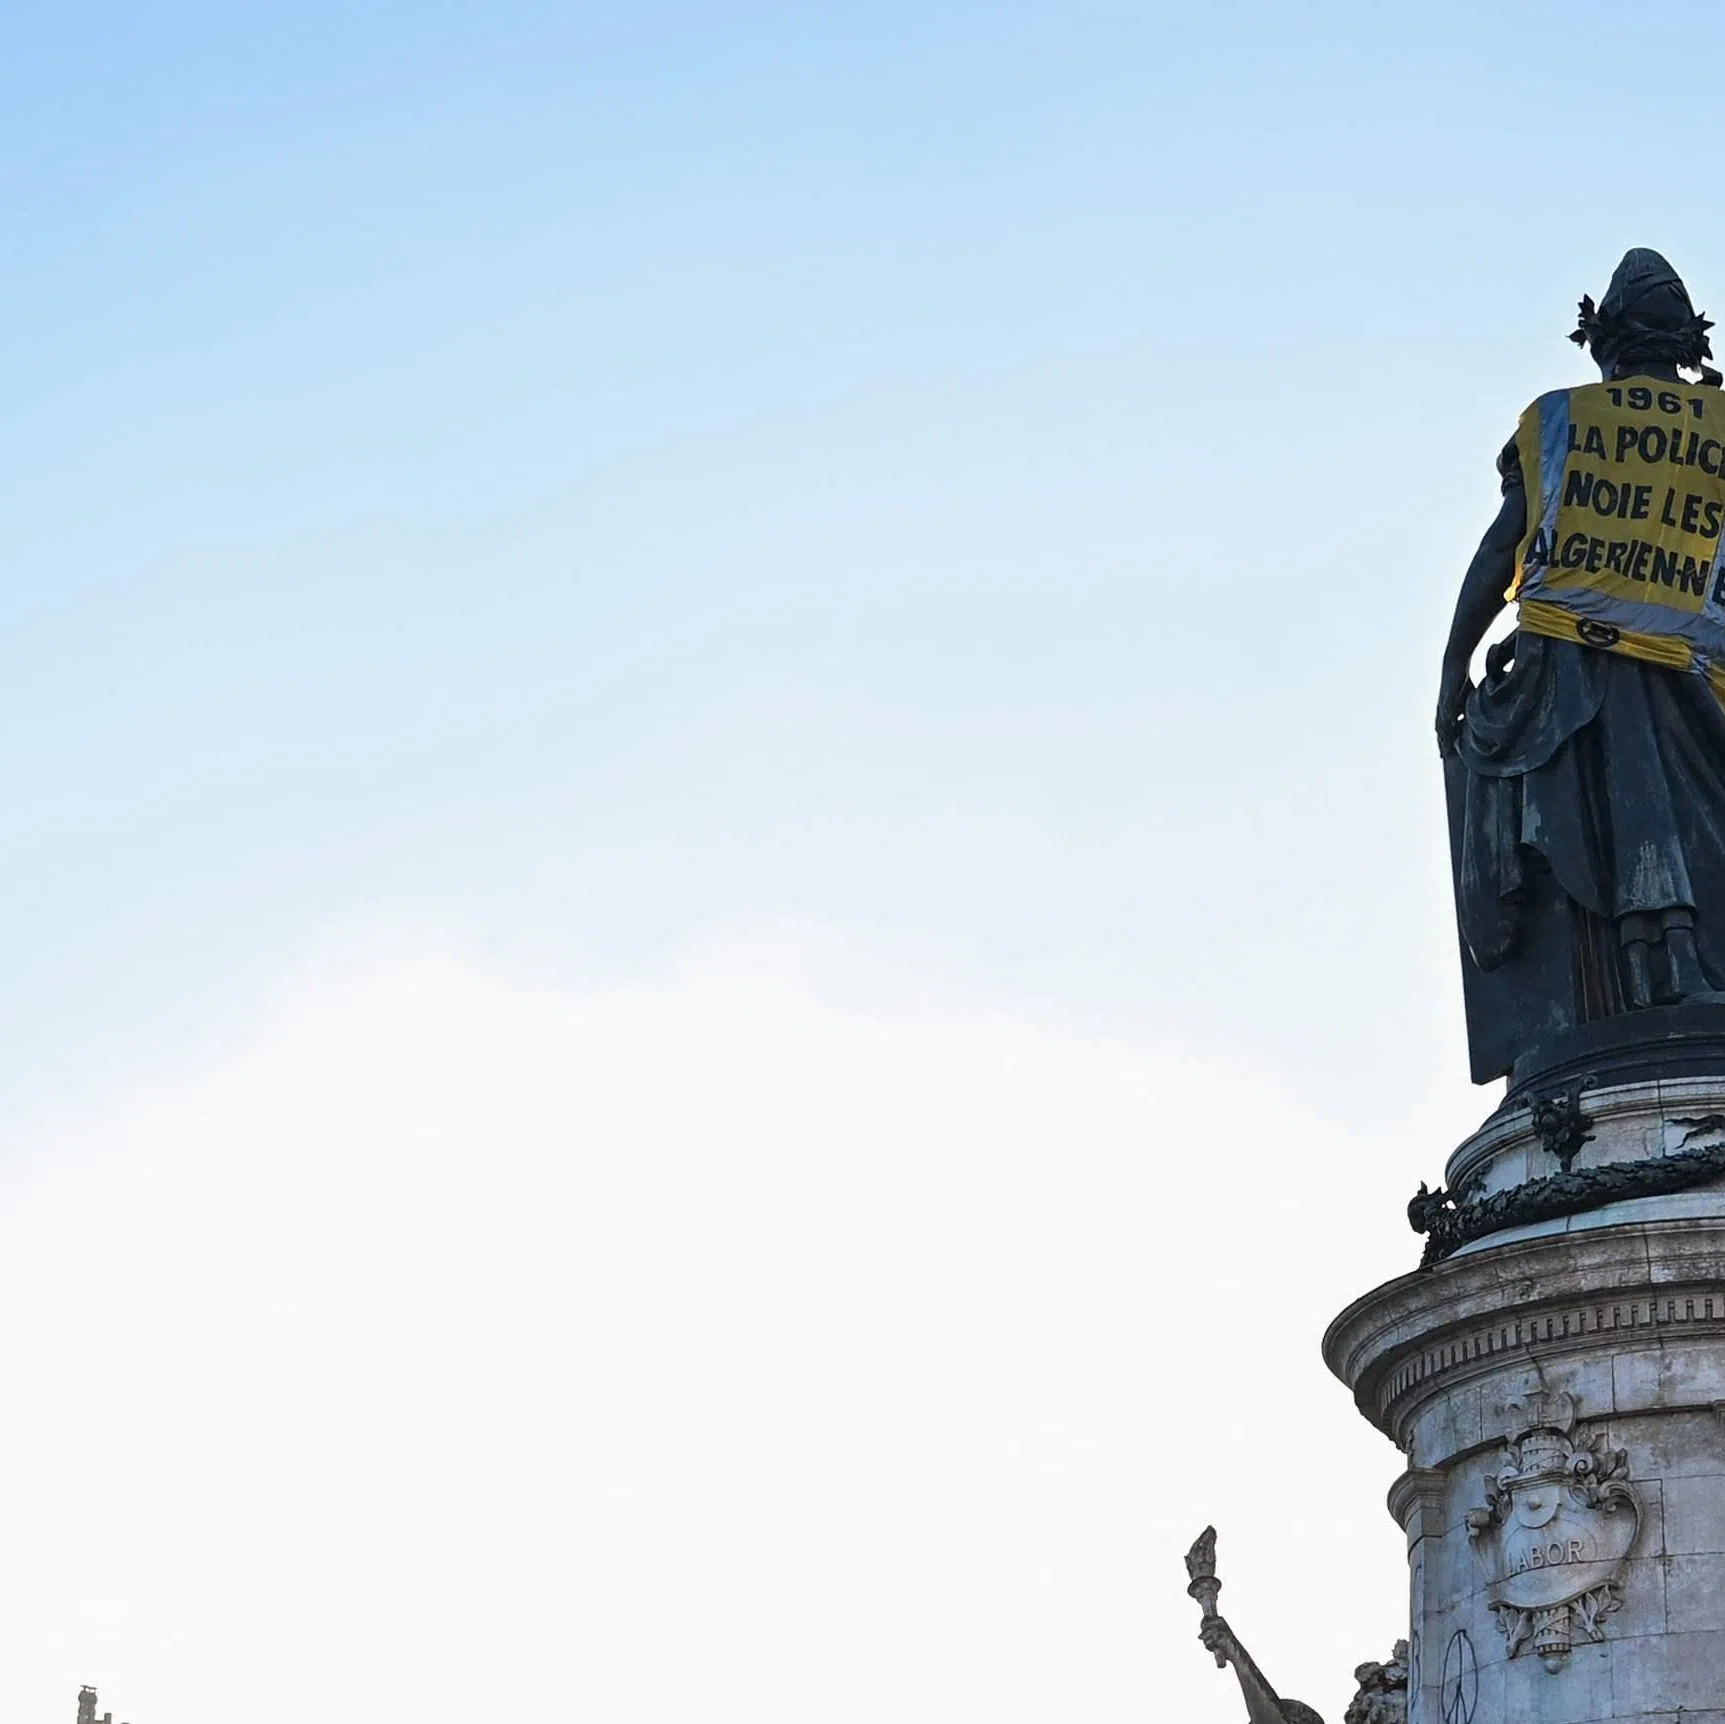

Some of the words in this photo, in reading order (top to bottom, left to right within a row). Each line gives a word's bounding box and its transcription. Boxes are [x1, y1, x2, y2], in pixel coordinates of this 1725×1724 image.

[1606, 387, 1704, 419] 1961
[1567, 423, 1606, 462] LA
[1563, 470, 1652, 520] NOIE
[1661, 487, 1723, 539] LES
[1508, 1539, 1584, 1574] LABOR
